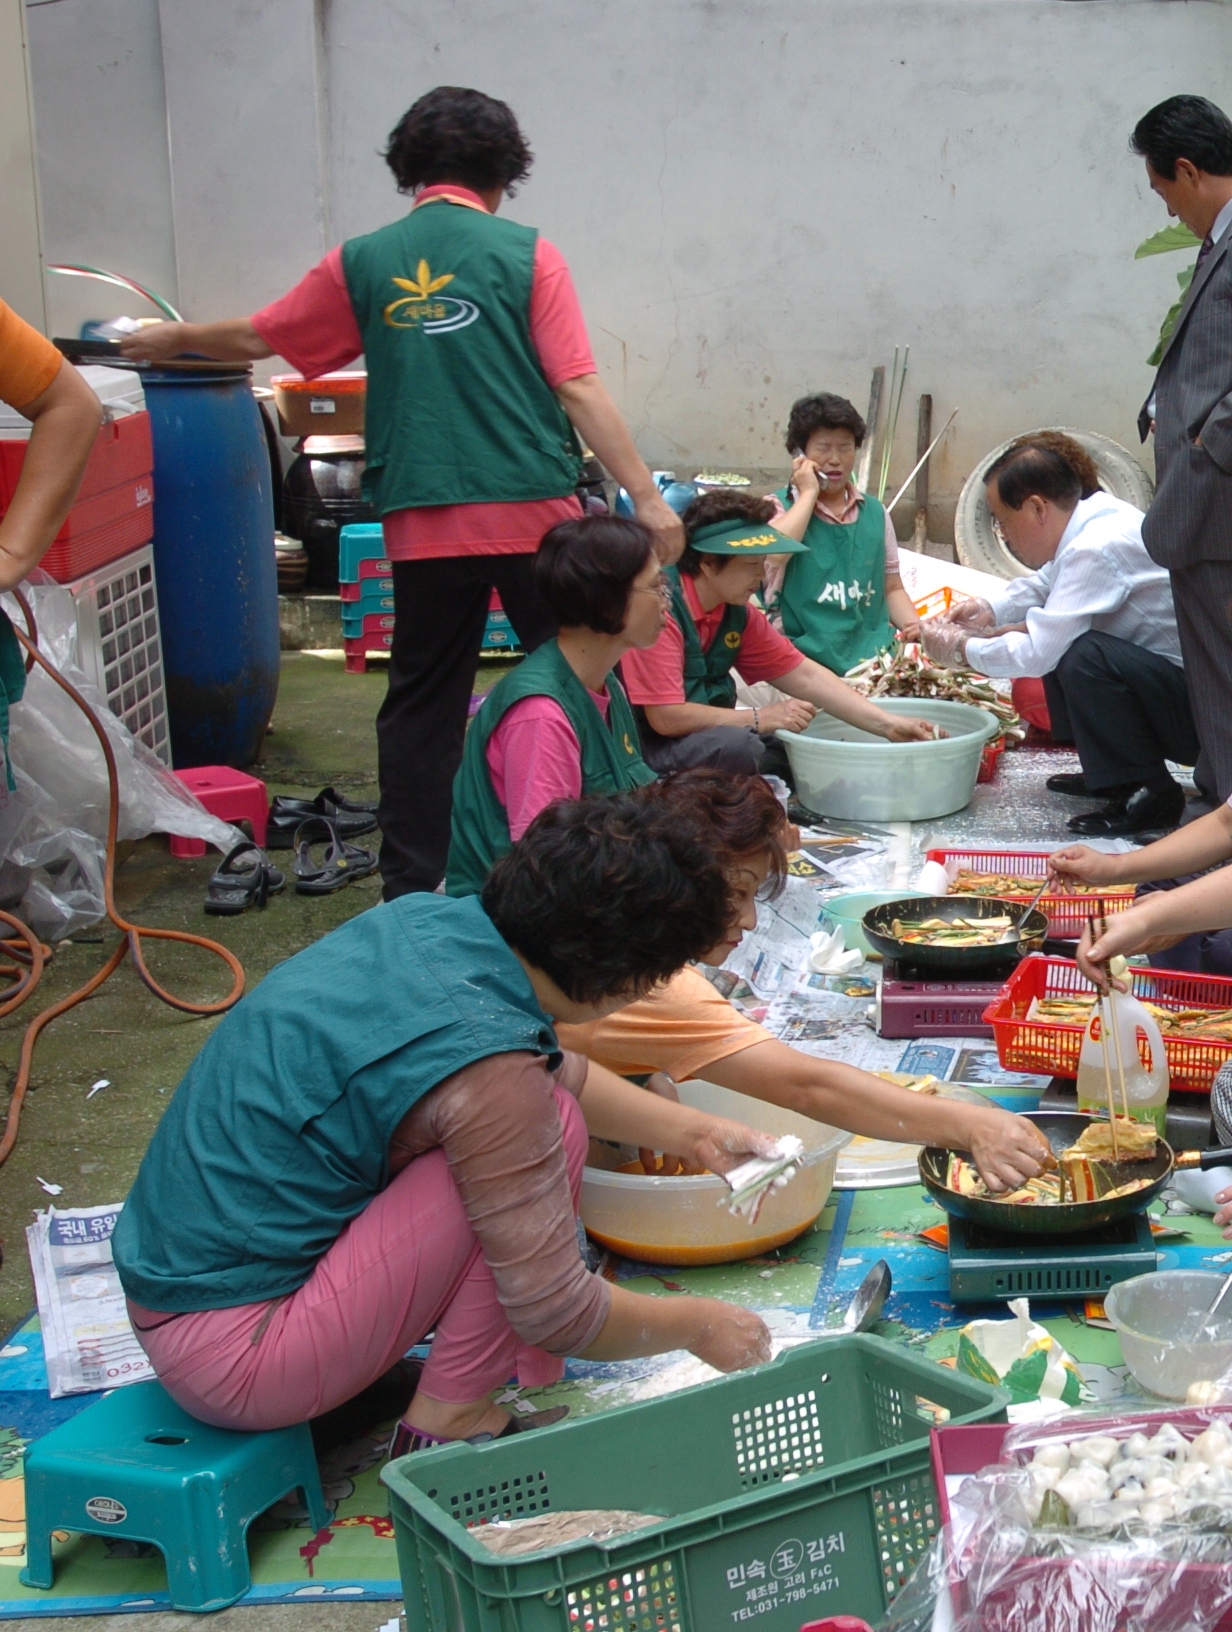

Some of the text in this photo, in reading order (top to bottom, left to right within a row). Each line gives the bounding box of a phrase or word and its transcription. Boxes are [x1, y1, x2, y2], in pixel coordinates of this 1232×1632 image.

[57, 1219, 87, 1237] 국내
[726, 1559, 767, 1590] 민속
[806, 1531, 845, 1562] 김치
[731, 1576, 840, 1622] TEL:031-798-5471
[745, 1564, 833, 1602] 제조원 고려 F&C
